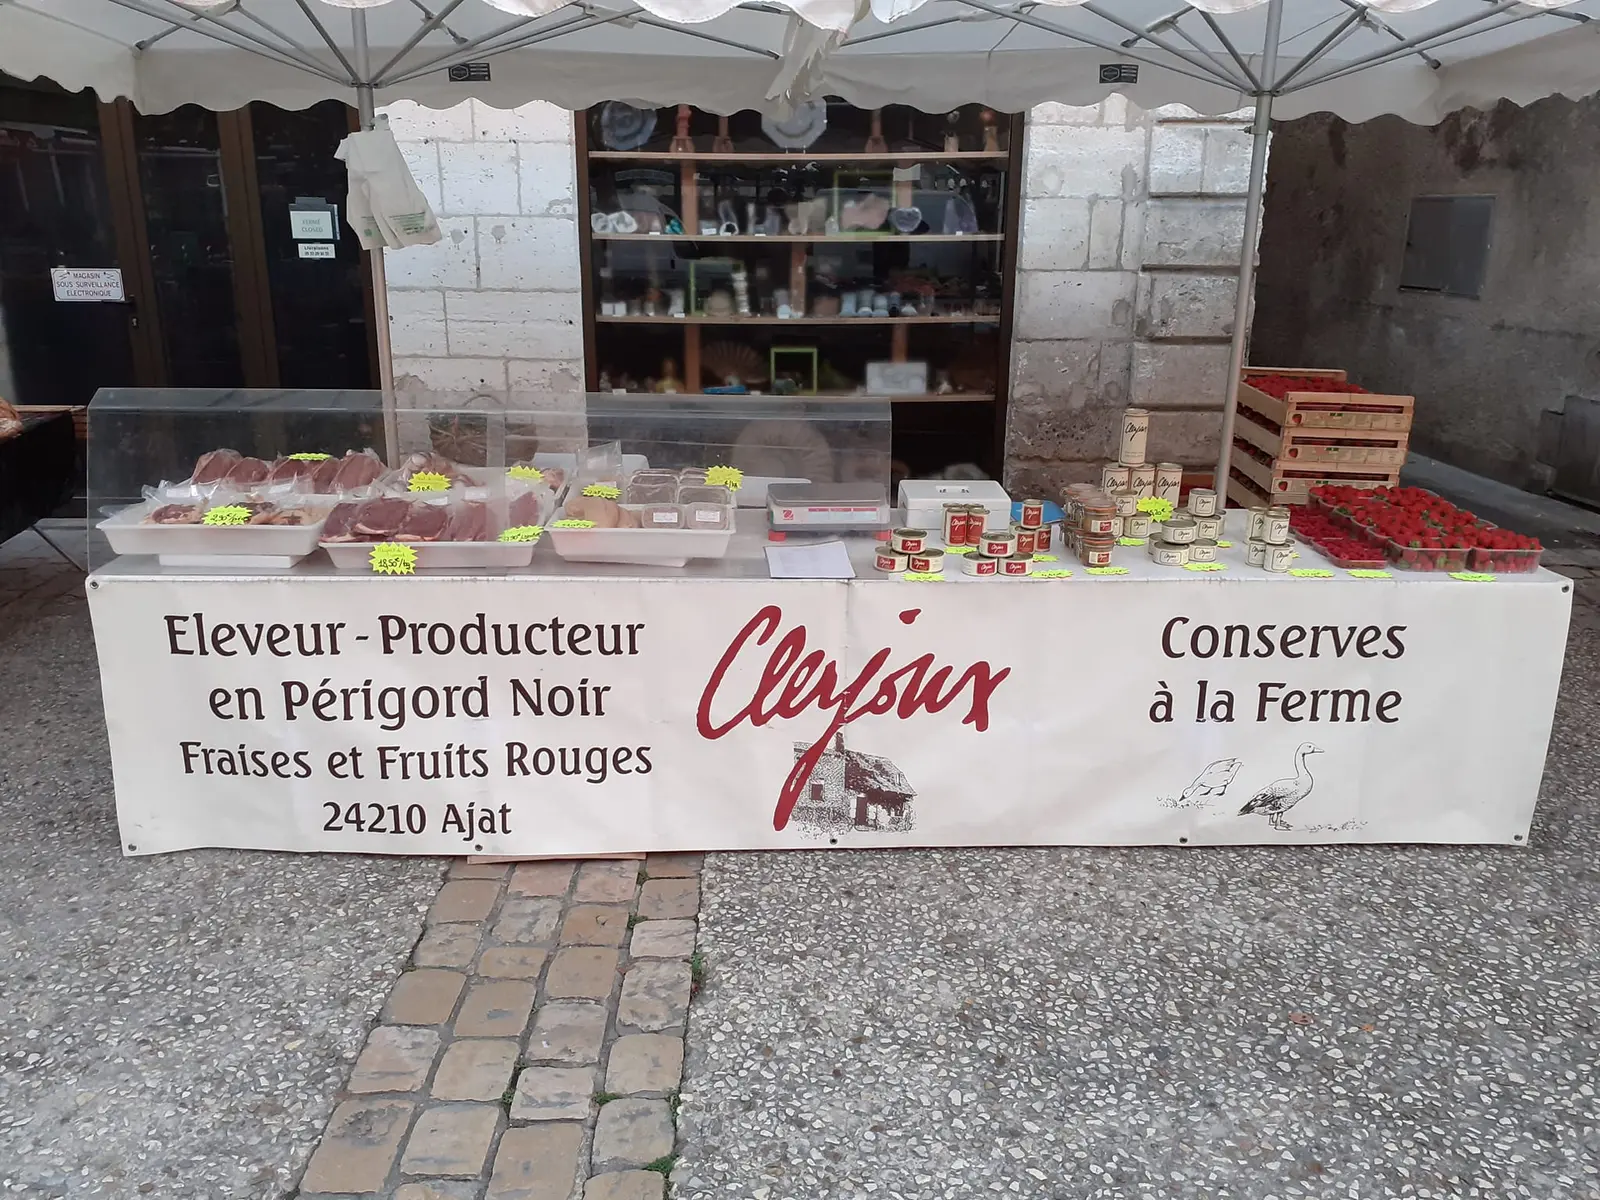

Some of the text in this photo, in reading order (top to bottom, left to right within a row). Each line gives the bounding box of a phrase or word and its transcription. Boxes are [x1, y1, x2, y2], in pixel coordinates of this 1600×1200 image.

[73, 272, 101, 280] MAGASIN
[76, 281, 120, 289] SURVEILLANCE
[164, 613, 346, 657] Eleveur
[378, 612, 646, 656] Producteur
[1162, 616, 1408, 660] Conserves
[209, 675, 612, 731] en Périgord Noir
[1150, 680, 1403, 723] à la Ferme
[180, 741, 653, 784] Fraises et Fruits Rouges
[323, 801, 512, 842] 24210 Ajat
